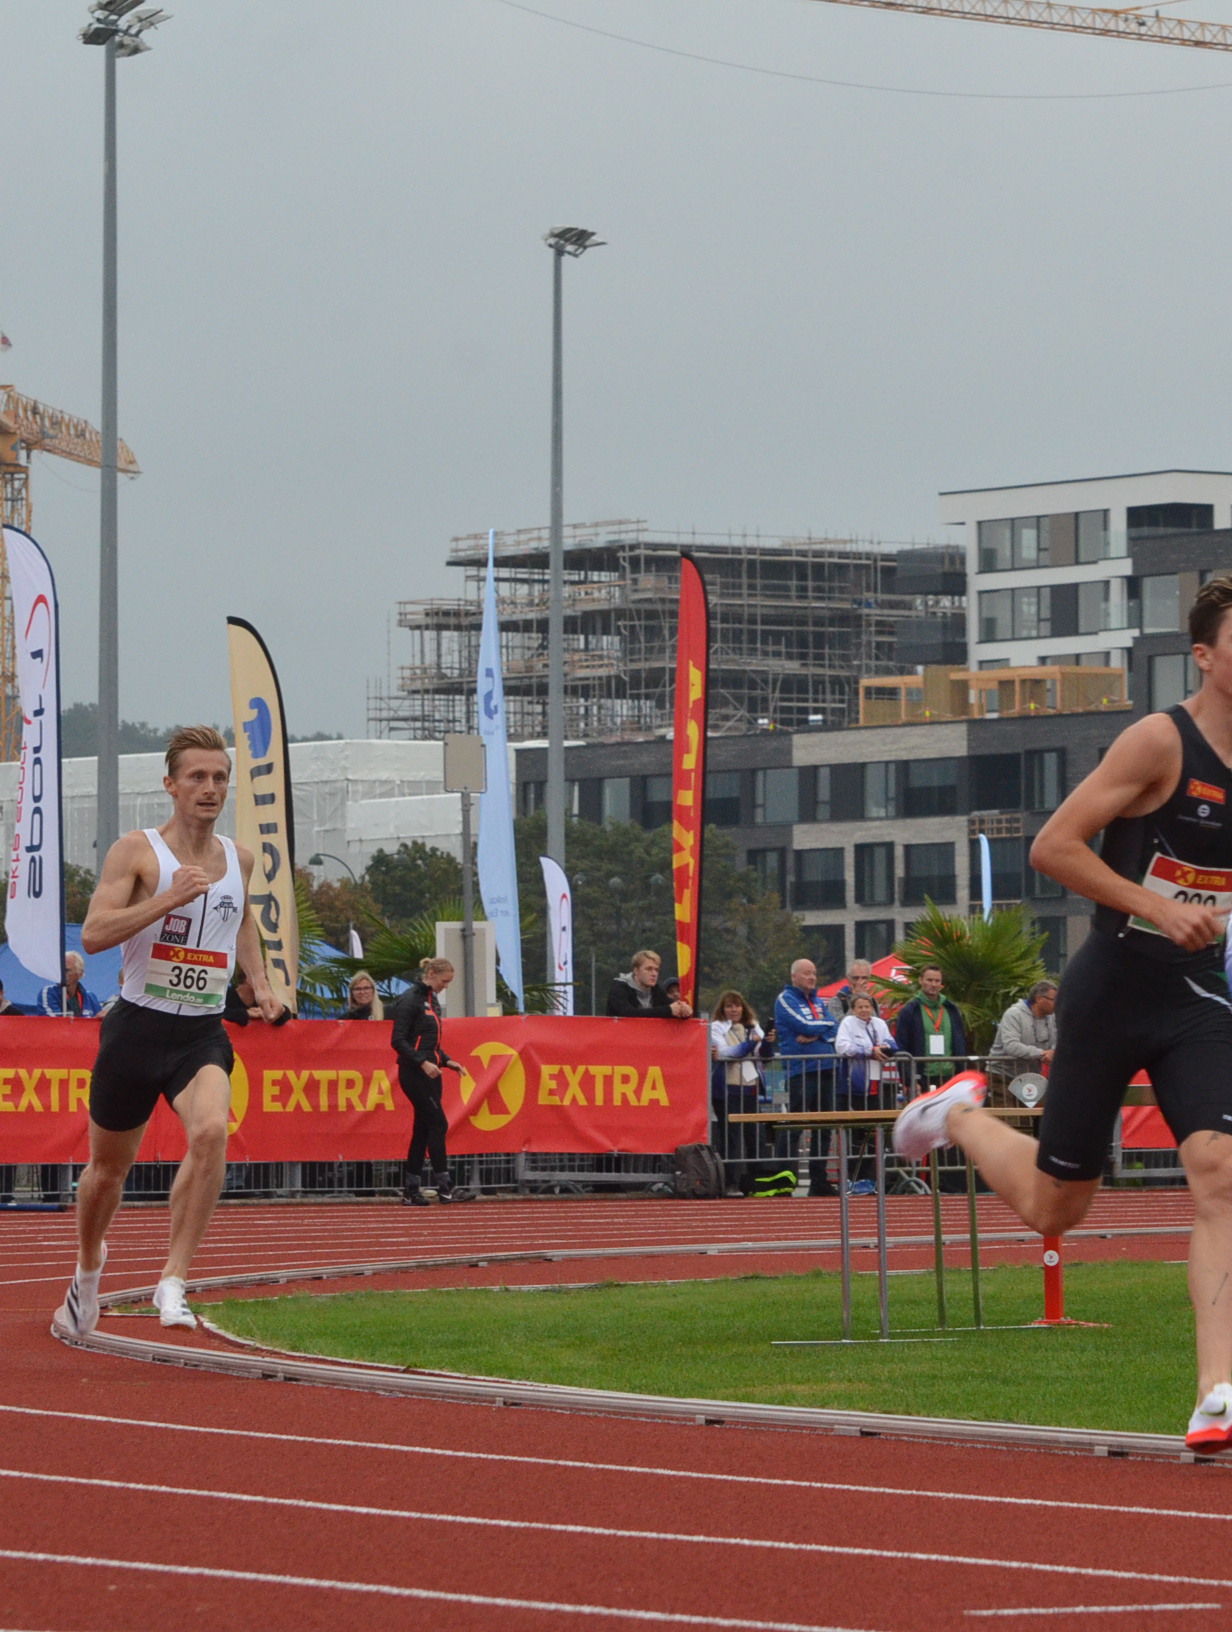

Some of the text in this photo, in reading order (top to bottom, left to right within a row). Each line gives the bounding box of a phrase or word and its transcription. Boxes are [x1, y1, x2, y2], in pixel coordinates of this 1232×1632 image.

[165, 917, 187, 933] JOB
[161, 933, 187, 944] ZONE
[186, 953, 215, 963] EXTRA
[168, 965, 208, 991] 366
[0, 1068, 91, 1113] EXTR
[262, 1069, 395, 1112] EXTRA
[538, 1064, 670, 1107] EXTRA
